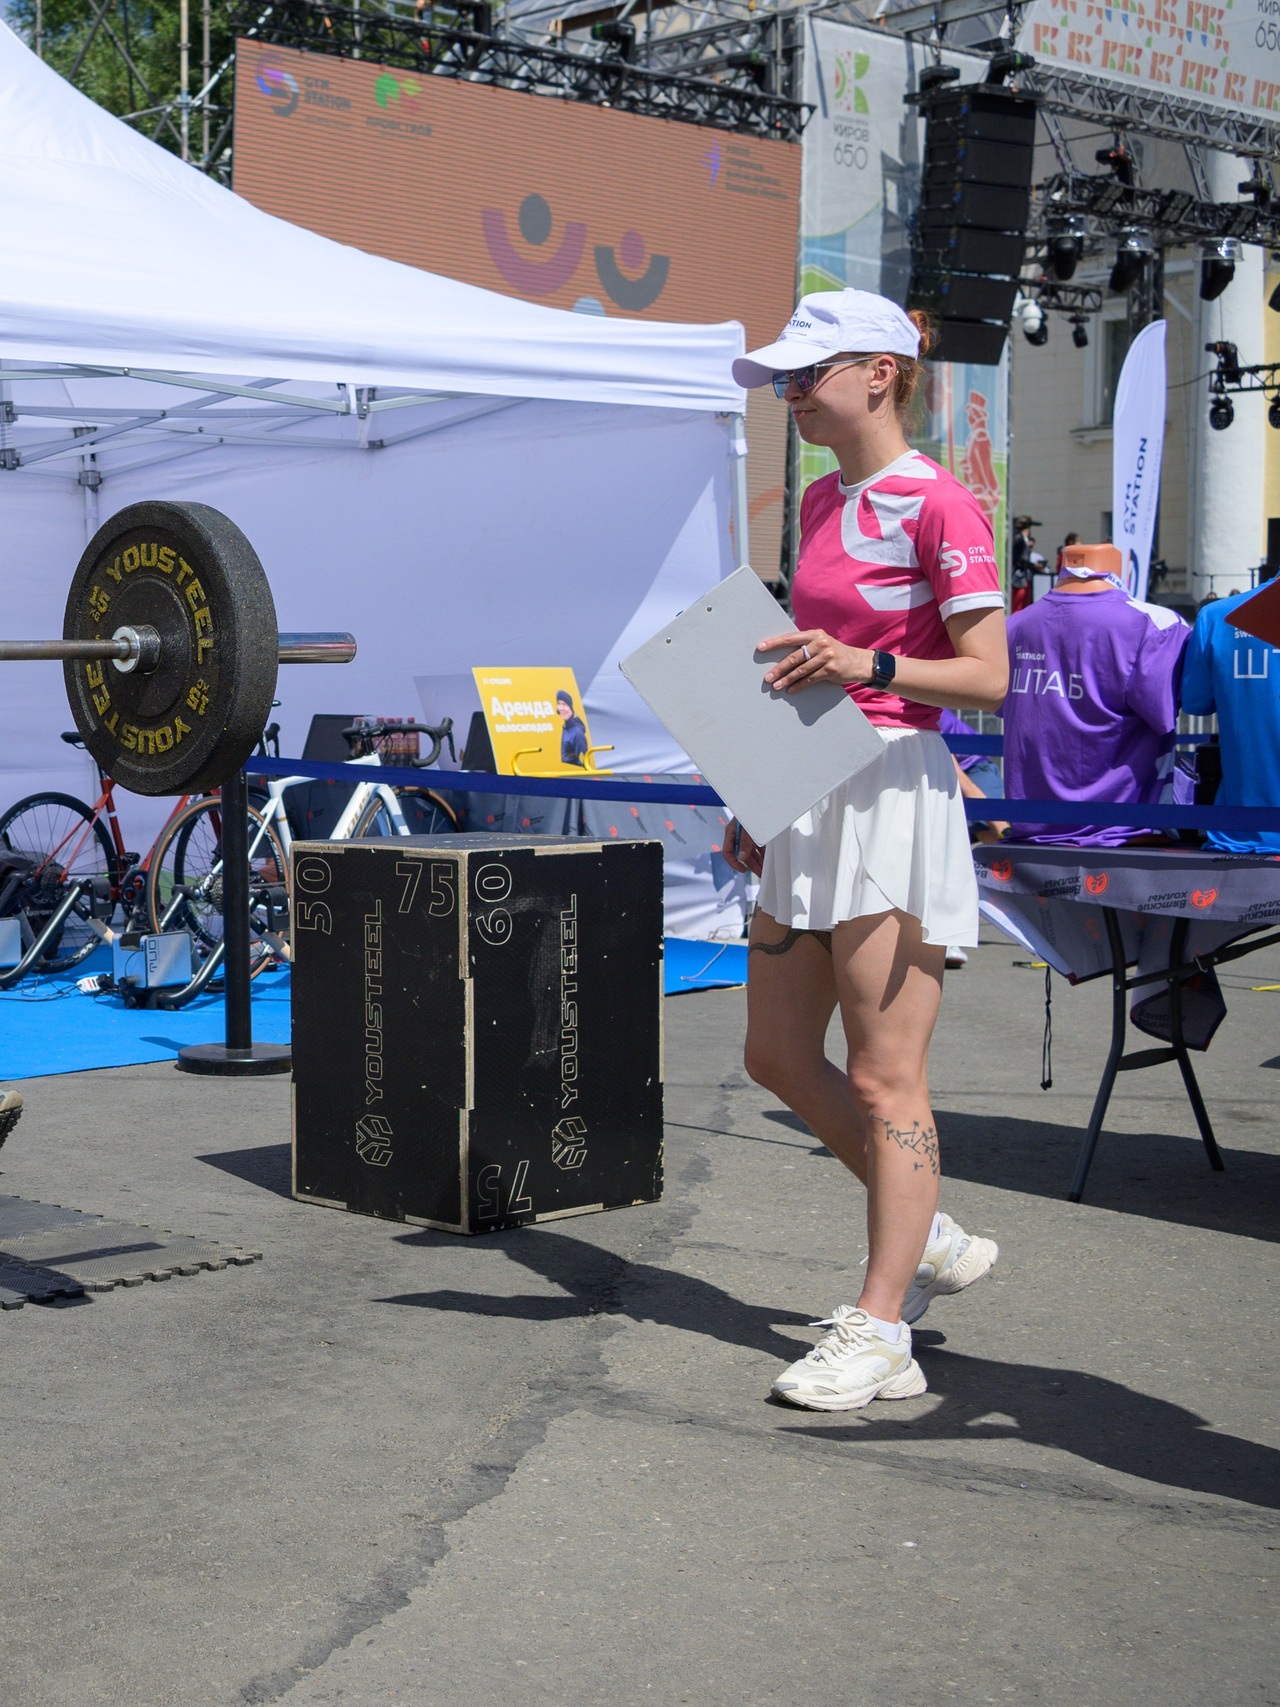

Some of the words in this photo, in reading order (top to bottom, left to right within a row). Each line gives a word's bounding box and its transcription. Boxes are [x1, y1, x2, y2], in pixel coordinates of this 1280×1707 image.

[1257, 0, 1280, 16] КИР
[1255, 20, 1280, 51] 65
[833, 122, 869, 143] КИРОВ
[833, 141, 869, 170] 650
[1129, 438, 1148, 536] STATION
[1123, 483, 1132, 534] GYM
[968, 546, 985, 555] GYM
[106, 542, 215, 666] YOUSTEEL
[1011, 668, 1084, 700] ШТАБ
[491, 695, 556, 722] Аренда
[495, 722, 554, 734] велосипедов
[296, 857, 332, 935] 50
[395, 861, 455, 917] 75
[1148, 891, 1189, 902] холмы
[475, 863, 513, 946] 60
[1137, 899, 1187, 912] Вятские
[1238, 908, 1280, 923] ятские
[1248, 900, 1280, 912] олмы
[364, 899, 383, 1105] YOUSTEEL
[560, 894, 578, 1109] YOUSTEEL
